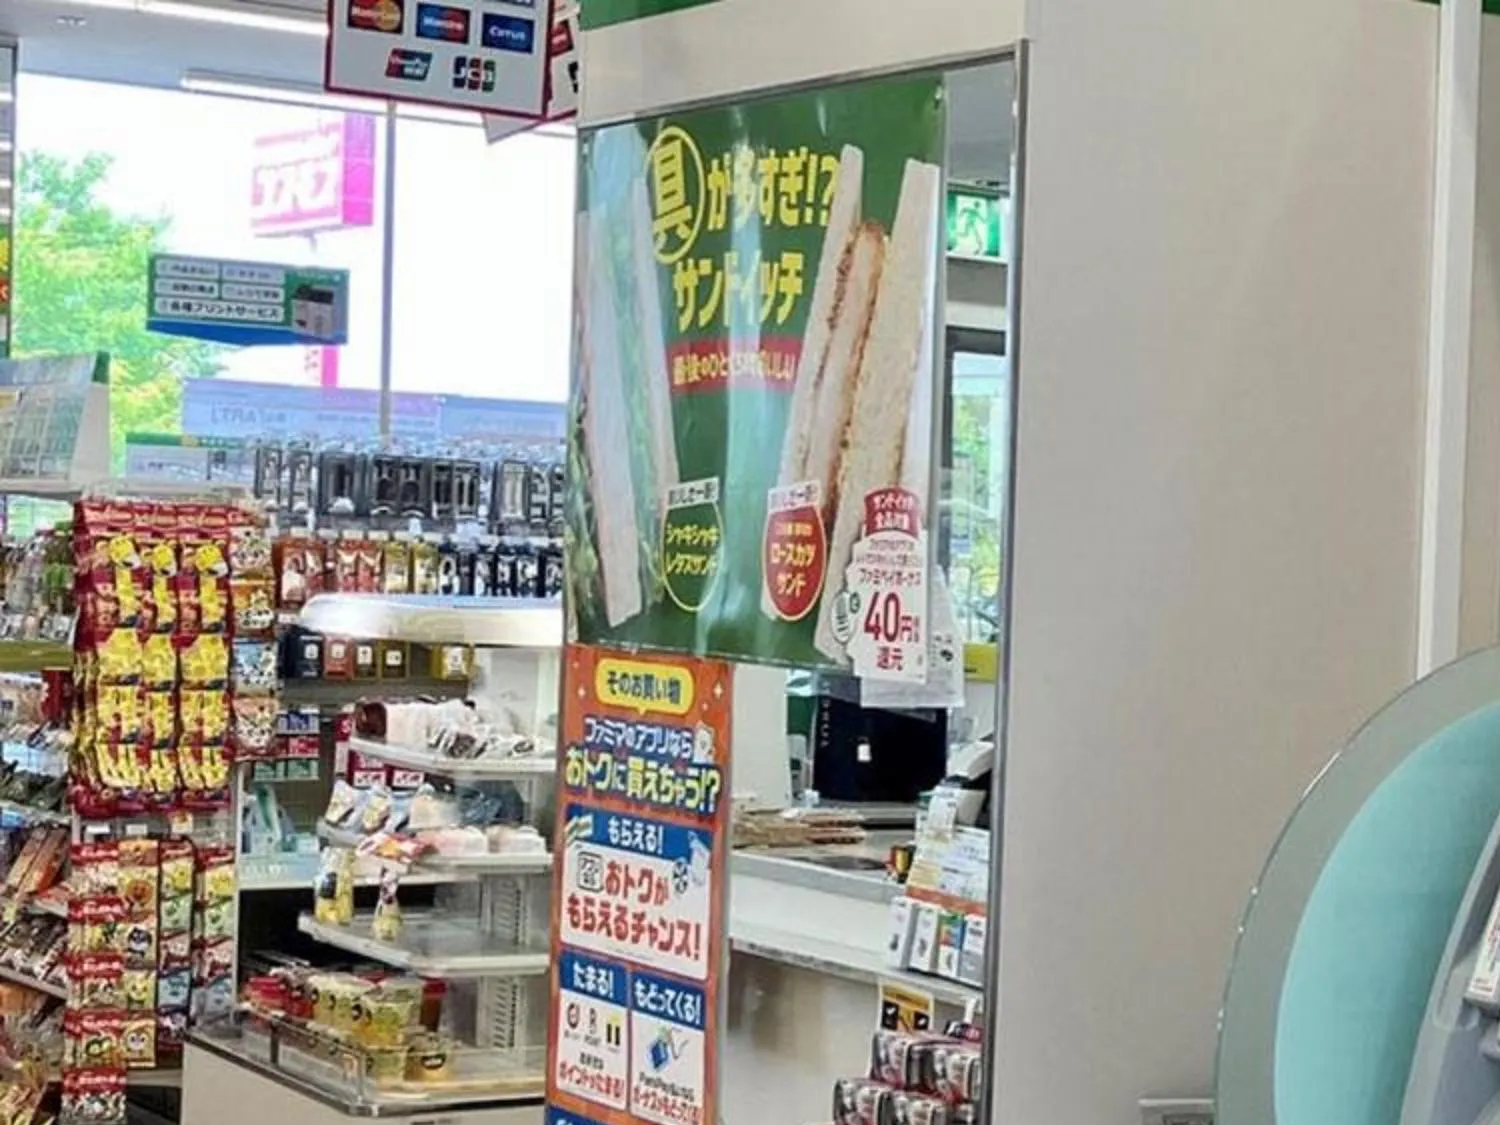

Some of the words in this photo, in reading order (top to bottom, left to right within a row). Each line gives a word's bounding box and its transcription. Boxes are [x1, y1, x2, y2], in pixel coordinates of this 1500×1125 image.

[672, 252, 805, 332] サンドイッチ
[607, 671, 682, 705] そのお買い物
[584, 717, 694, 760] ファミマのアプリなら
[607, 817, 664, 855] もらえる!
[605, 862, 671, 906] おトクが
[567, 895, 702, 961] もらえるチャンス!
[573, 962, 615, 999] たまる!
